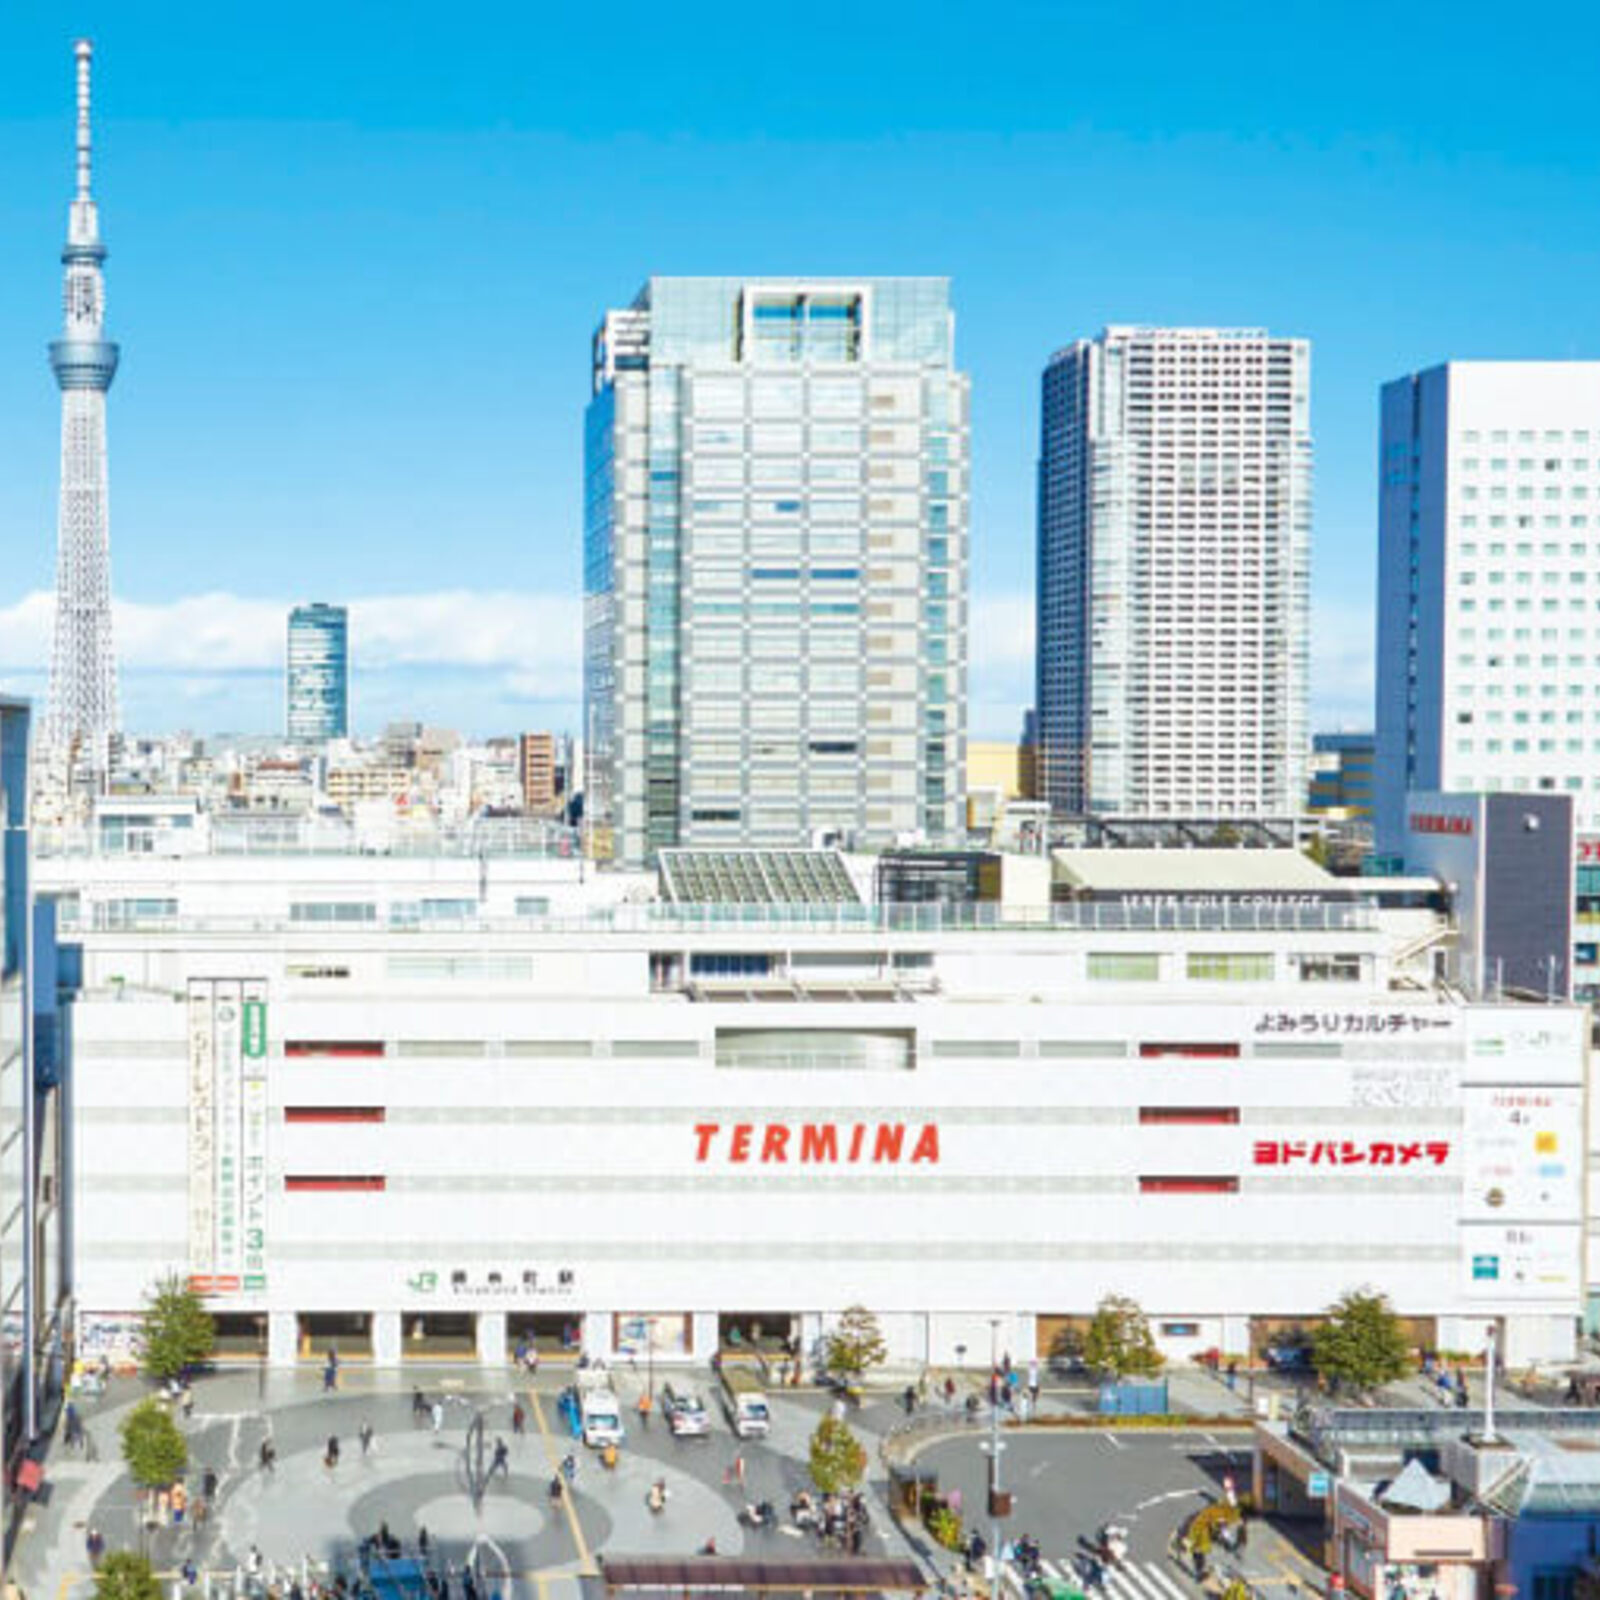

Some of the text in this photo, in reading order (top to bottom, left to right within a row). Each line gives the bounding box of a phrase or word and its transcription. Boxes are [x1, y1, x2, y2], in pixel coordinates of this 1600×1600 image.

[1255, 1013, 1452, 1033] よみうりカルチャー
[693, 1123, 940, 1163] TERMINA
[1253, 1141, 1450, 1165] ヨドバシカメラ
[408, 1271, 438, 1293] JR
